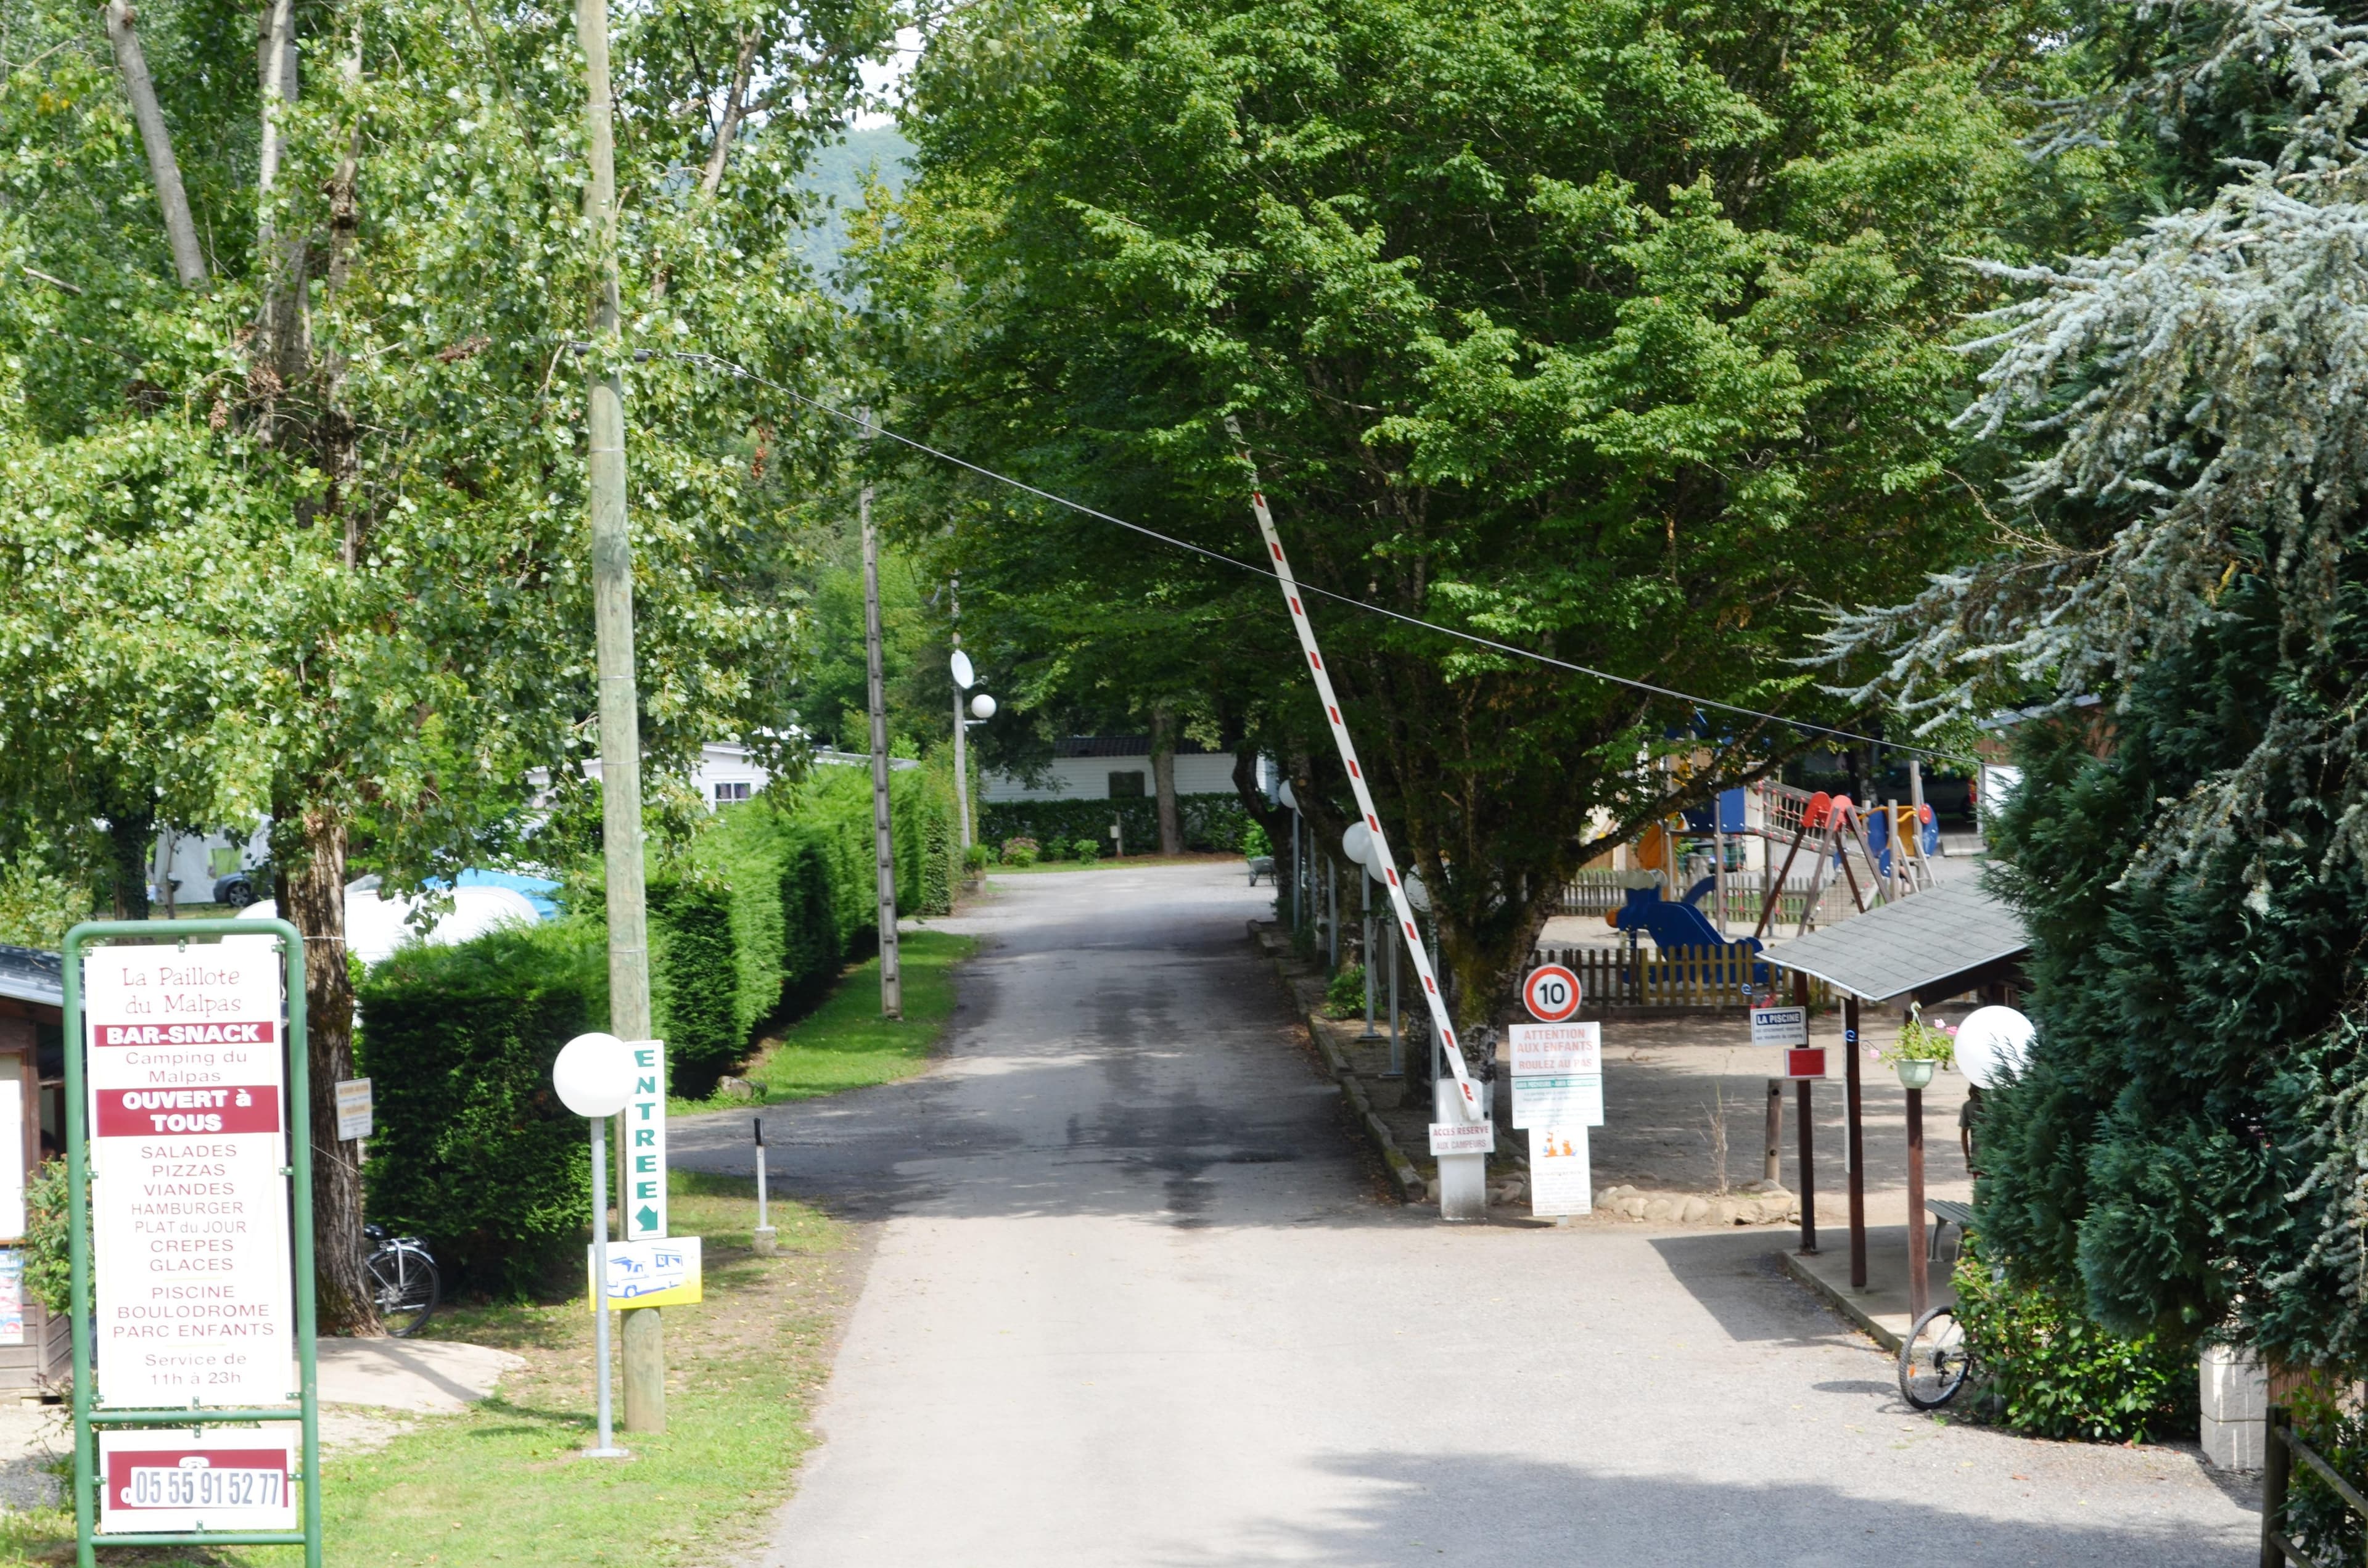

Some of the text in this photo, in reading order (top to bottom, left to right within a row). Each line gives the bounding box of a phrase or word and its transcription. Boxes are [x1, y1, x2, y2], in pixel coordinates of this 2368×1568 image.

[123, 967, 239, 986] La Paillote
[1540, 983, 1565, 1004] 10
[126, 994, 240, 1017] du Malpas
[1757, 1013, 1800, 1024] LA PISCINE
[107, 1024, 260, 1045] BAR-SNACK
[1524, 1028, 1585, 1040] ATTENTION
[1517, 1041, 1593, 1053] AUX ENFANTS
[126, 1051, 246, 1065] Camping du
[1519, 1059, 1592, 1069] ROULEZ AU PAS
[150, 1070, 220, 1085] Malpas
[123, 1089, 251, 1109] OUVERT à
[150, 1114, 222, 1131] TOUS
[635, 1051, 657, 1199] ENTREE
[142, 1144, 236, 1159] SALADES
[1436, 1141, 1449, 1149] AUX
[153, 1164, 225, 1176] PIZZAS
[144, 1183, 234, 1196] VIANDES
[132, 1202, 243, 1214] HAMBURGER
[136, 1221, 246, 1233] PLAT du JOUR
[151, 1239, 233, 1252] CREPES
[150, 1258, 232, 1271] GLACES
[152, 1286, 234, 1299] PISCINE
[118, 1305, 268, 1318] BOULODROME
[114, 1323, 273, 1337] PARC ENFANTS
[146, 1353, 246, 1366] Service de
[152, 1374, 181, 1384] 11h
[209, 1372, 240, 1384] 23h
[136, 1471, 278, 1504] 05 55 91 52 77
